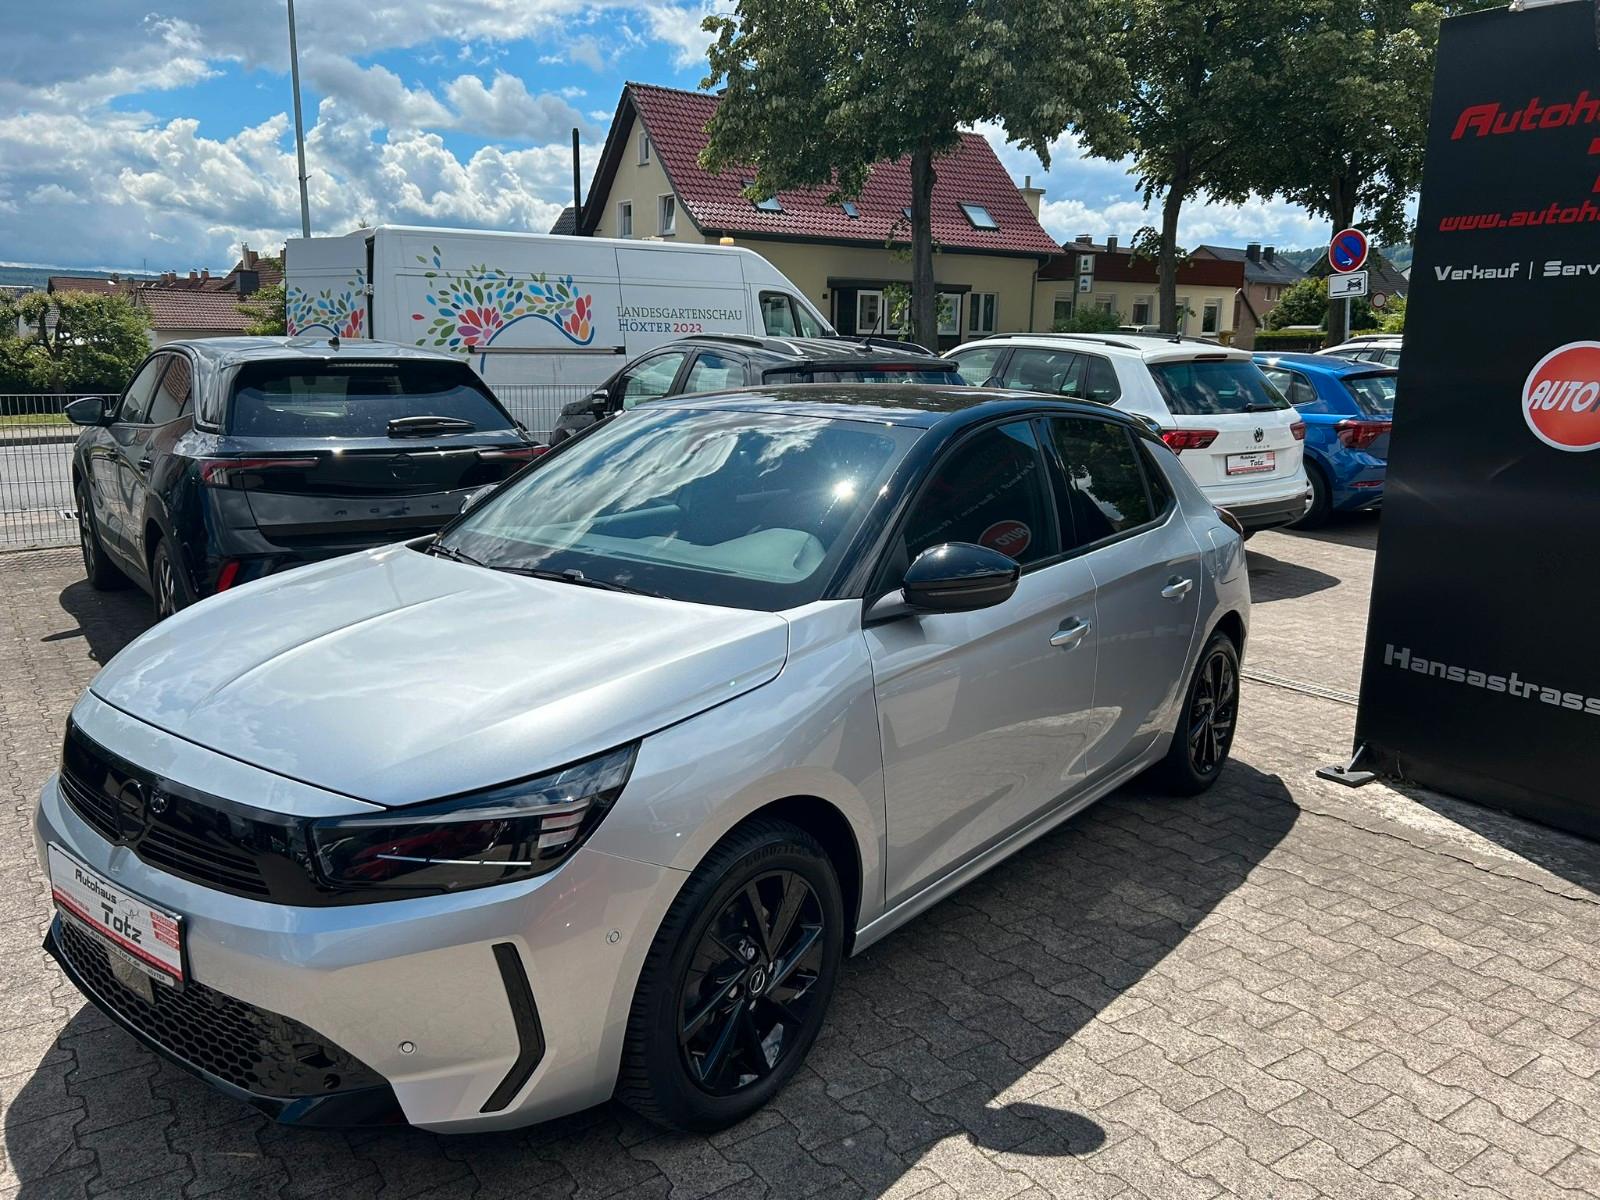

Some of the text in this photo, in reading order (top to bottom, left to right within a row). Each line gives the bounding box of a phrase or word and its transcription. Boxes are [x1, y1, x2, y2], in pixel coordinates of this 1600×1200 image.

[1451, 90, 1600, 140] Autoh
[1439, 200, 1600, 231] www.autoh
[1434, 260, 1600, 281] Verkauf Serv
[616, 306, 742, 320] LANDESGARTENSCHAU
[618, 318, 672, 333] HÖXTER
[1528, 380, 1600, 412] AUTO
[1384, 643, 1600, 716] Hansastrass
[75, 868, 117, 904] Autohaus
[101, 902, 142, 945] Totz
